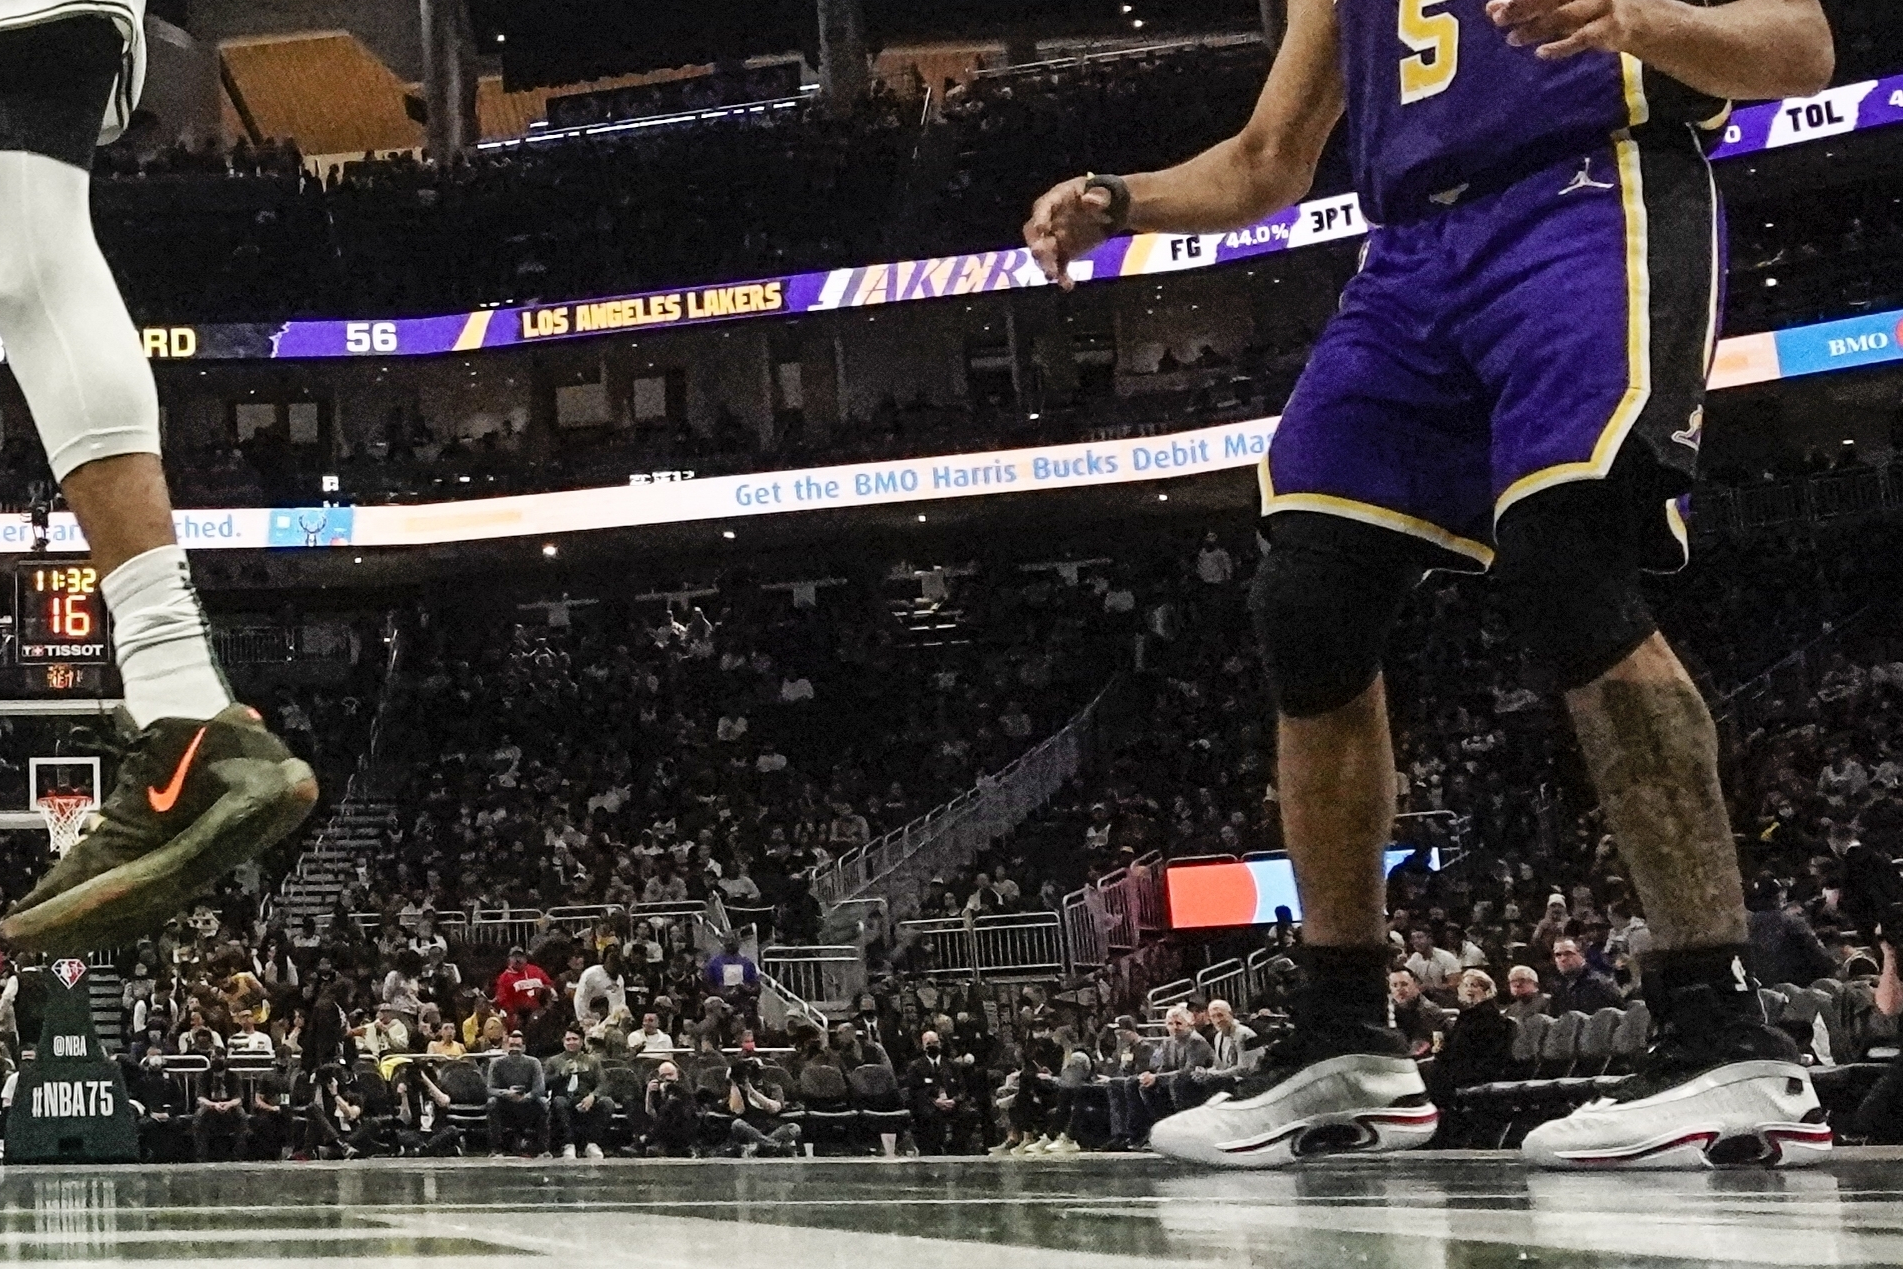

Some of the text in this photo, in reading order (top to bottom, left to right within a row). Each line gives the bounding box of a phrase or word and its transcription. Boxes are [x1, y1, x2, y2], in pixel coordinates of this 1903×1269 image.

[1786, 100, 1844, 132] TOL
[1171, 203, 1355, 261] FG 44.0% 3PT
[807, 244, 1042, 311] LAKER
[522, 281, 782, 339] LOS ANGELES LAKERS
[134, 328, 197, 358] RD
[346, 322, 397, 352] 56
[1828, 332, 1888, 357] BMO
[736, 482, 782, 507] Get
[794, 477, 840, 501] the
[854, 472, 918, 497] BMO
[932, 459, 1017, 490] Harris
[1033, 450, 1119, 481] Bucks
[1133, 439, 1210, 472] Debit
[36, 568, 96, 593] 11:32
[53, 595, 90, 636] 16
[45, 644, 104, 656] TISSOT
[53, 1035, 88, 1057] @NBA
[32, 1081, 114, 1118] #NBA75
